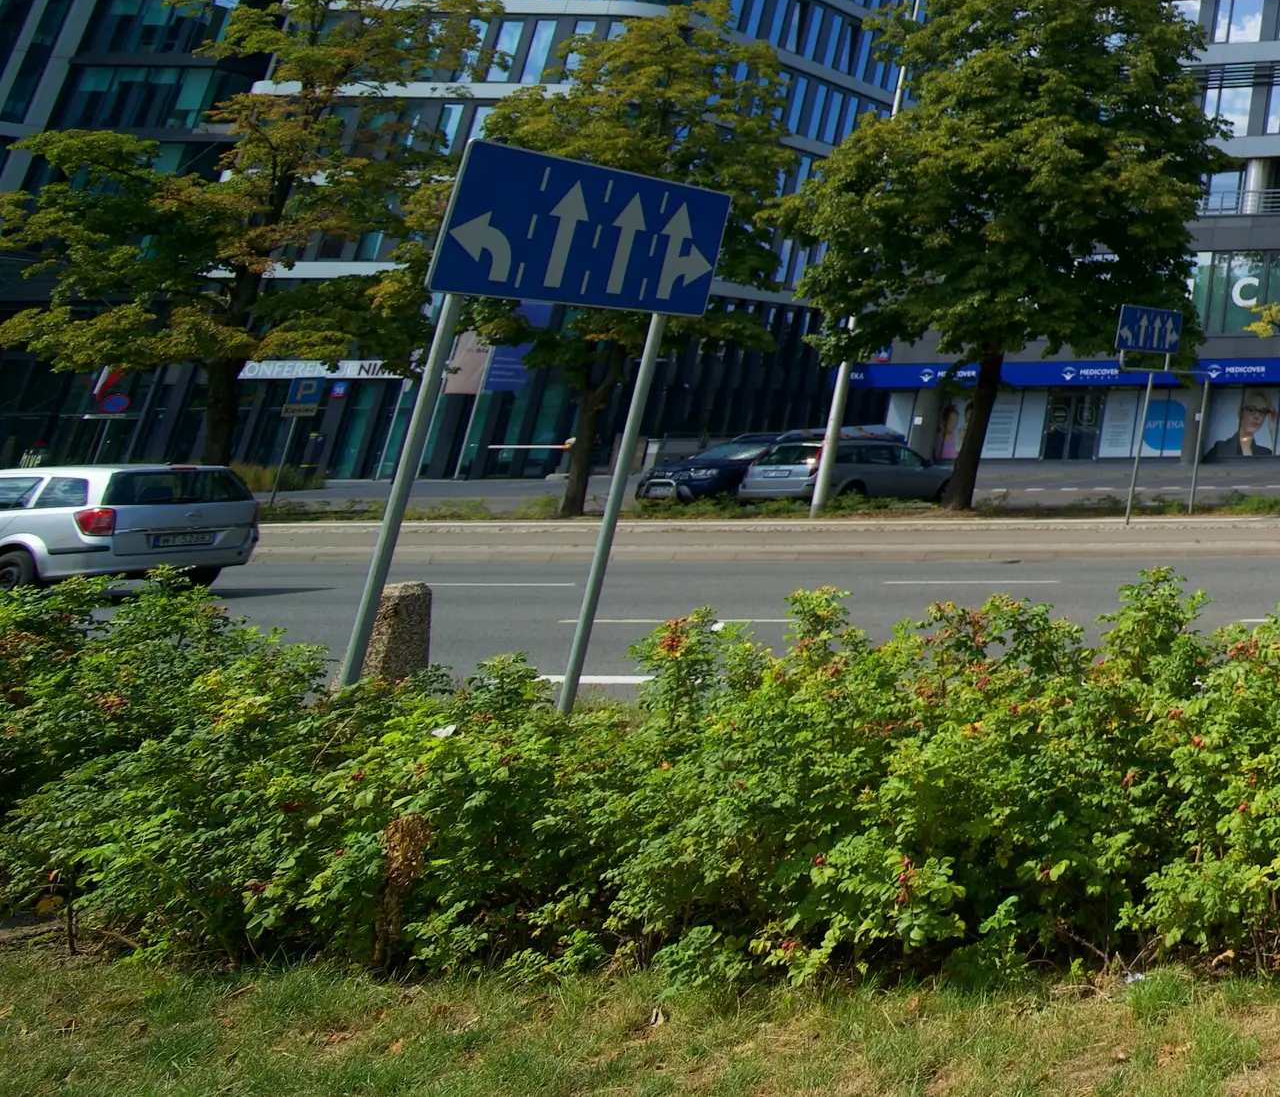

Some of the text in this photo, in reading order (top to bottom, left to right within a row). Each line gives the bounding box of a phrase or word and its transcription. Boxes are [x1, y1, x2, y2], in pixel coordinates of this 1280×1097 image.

[1079, 368, 1120, 376] MEDICOVER
[1225, 365, 1266, 374] MEDICOVER
[283, 406, 316, 416] Koniec
